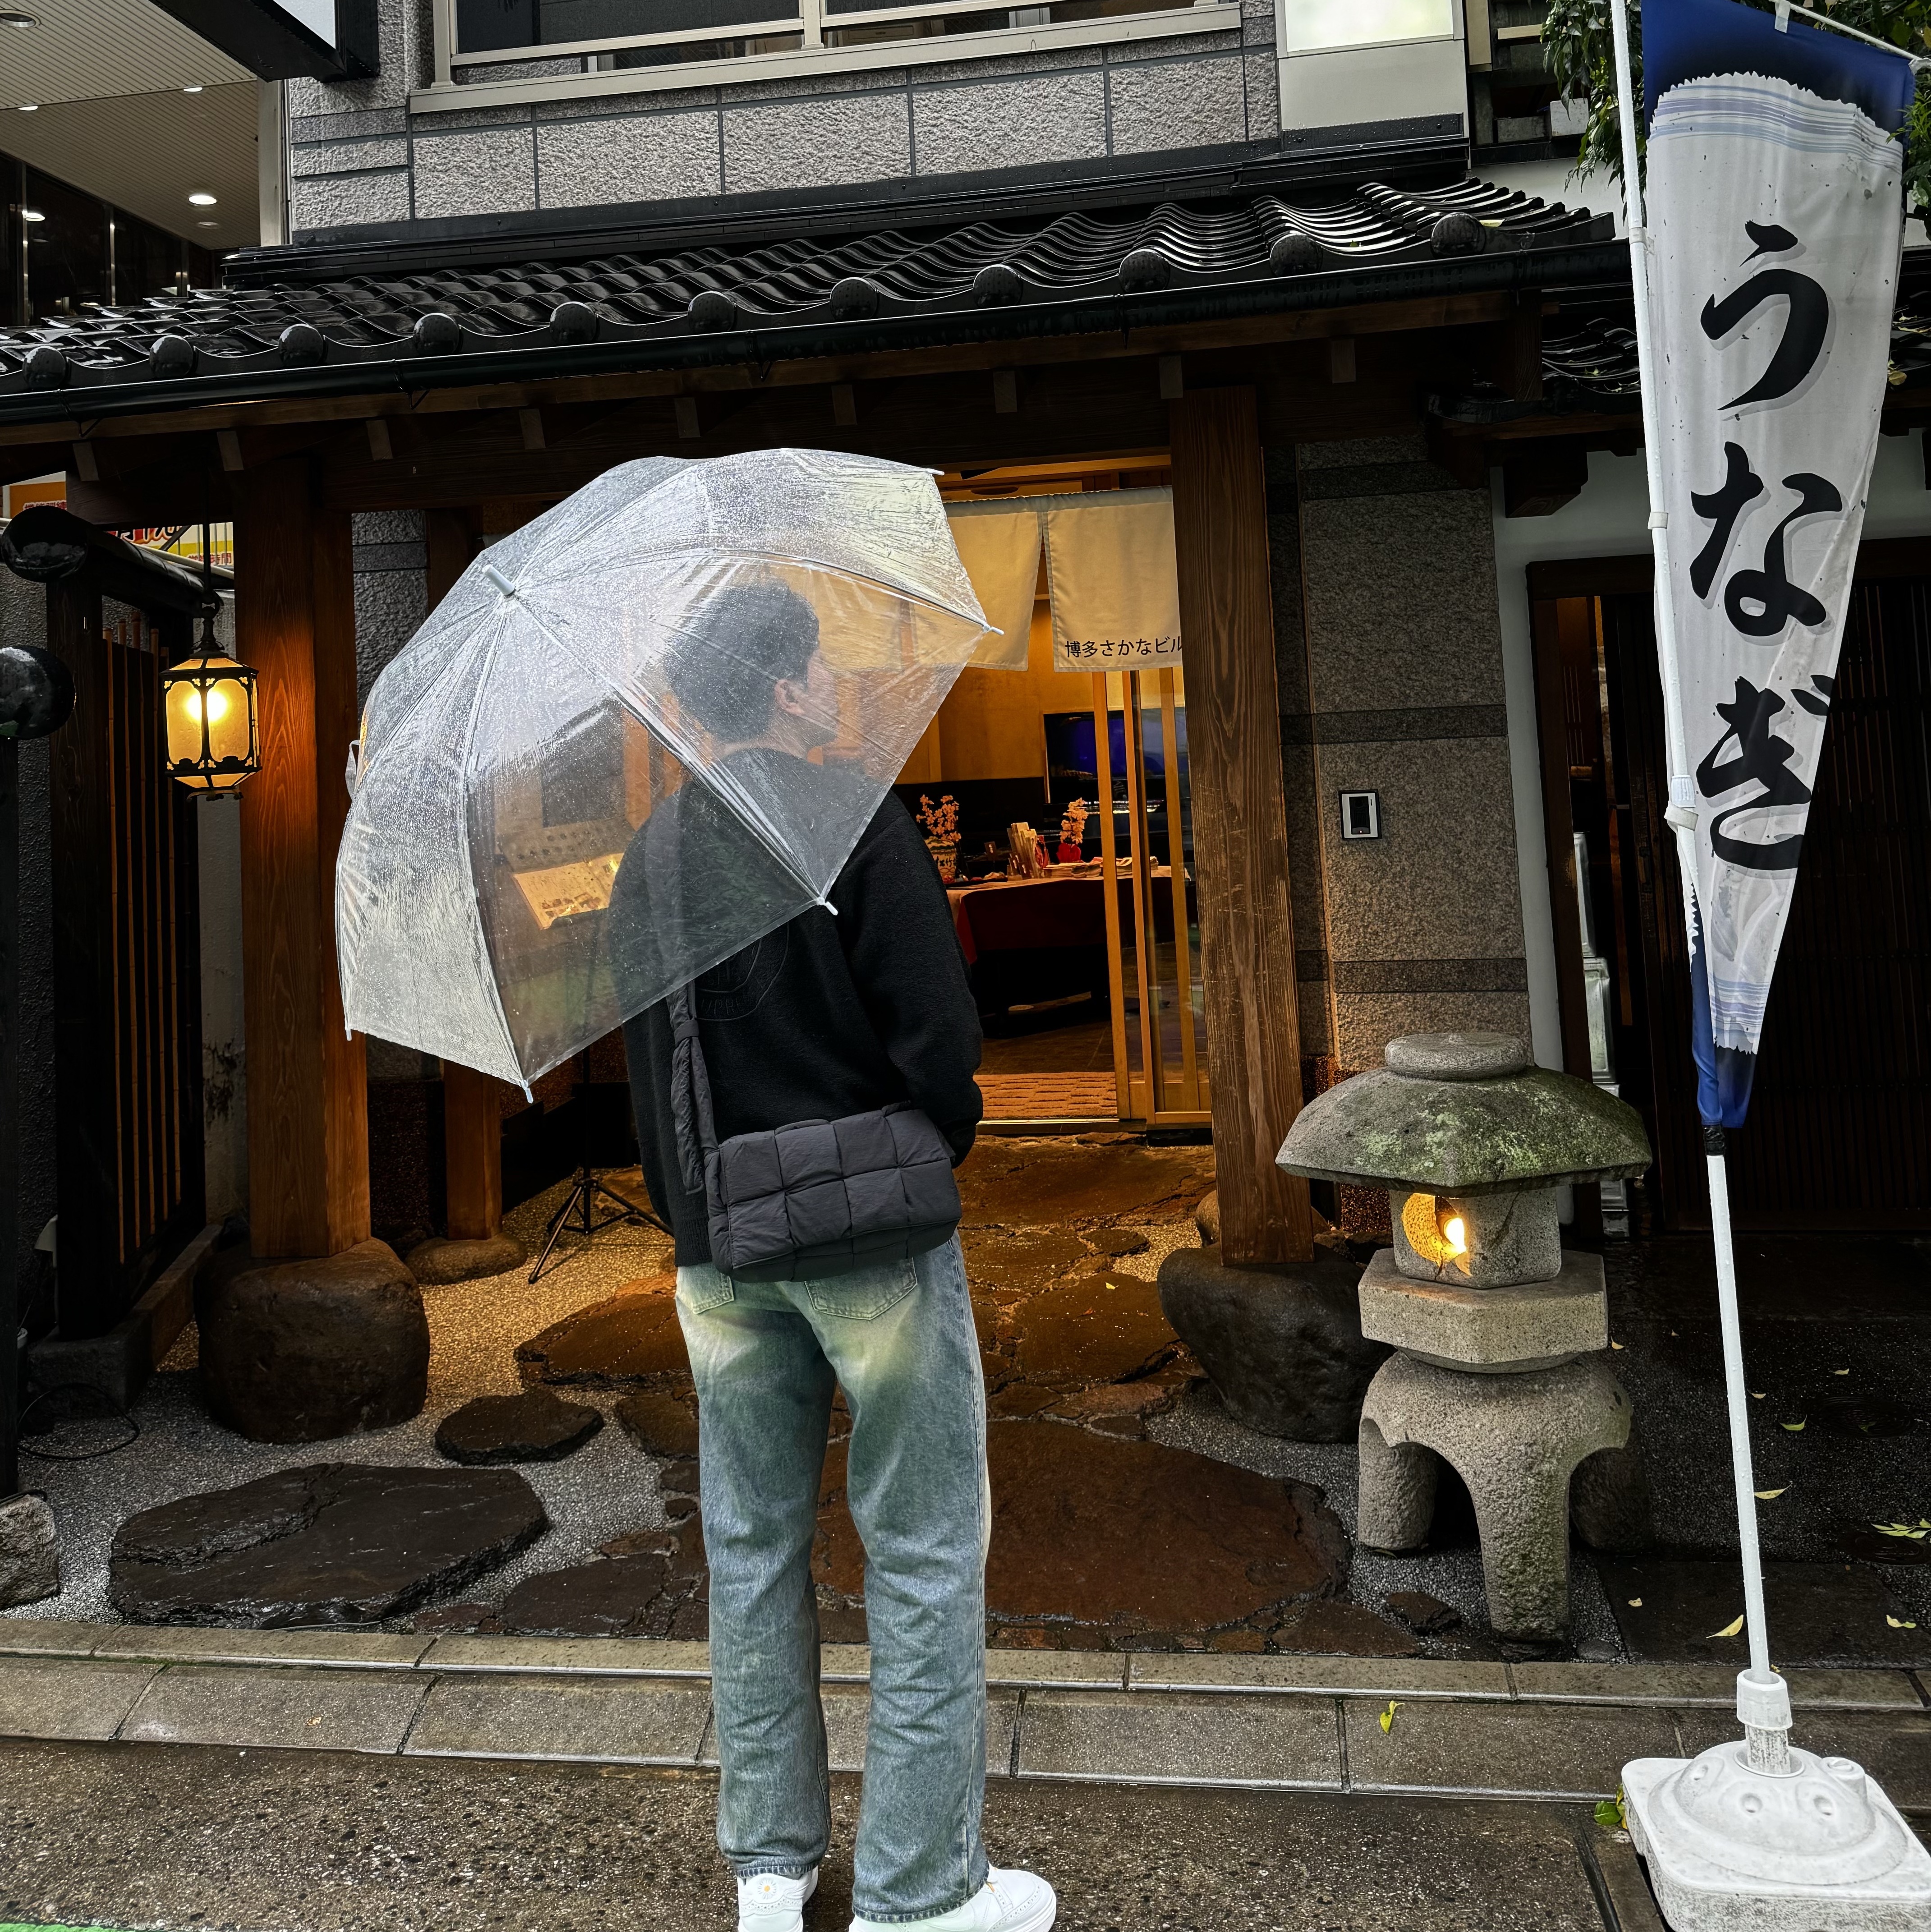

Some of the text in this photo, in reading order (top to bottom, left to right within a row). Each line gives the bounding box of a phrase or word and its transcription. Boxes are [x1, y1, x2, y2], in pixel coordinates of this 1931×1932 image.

[1064, 636, 1182, 658] 博多さかなビル
[1691, 220, 1843, 870] うなぎ
